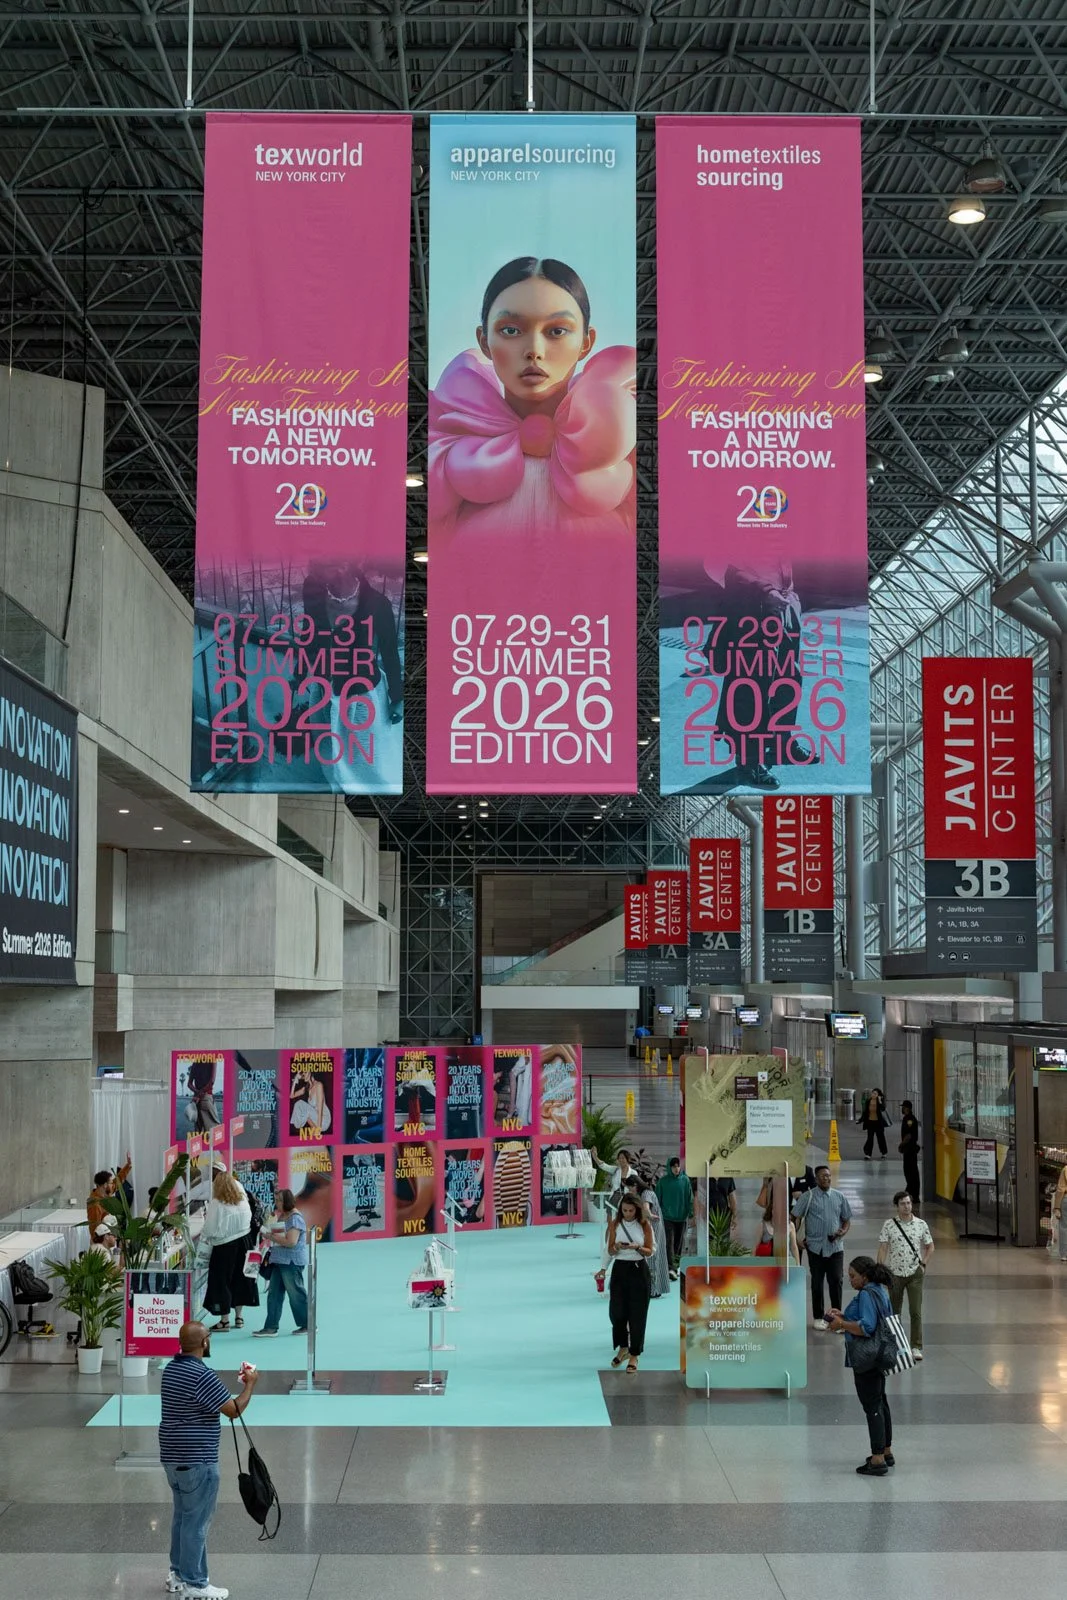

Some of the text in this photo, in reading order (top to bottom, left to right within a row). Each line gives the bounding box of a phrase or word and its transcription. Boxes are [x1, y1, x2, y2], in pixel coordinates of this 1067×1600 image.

[255, 143, 363, 166] texworld
[450, 143, 615, 168] apparelsourcing
[697, 145, 821, 164] hometextiles
[256, 171, 345, 182] NEW YORK CITY
[451, 171, 540, 180] NEW YORK CITY
[697, 168, 783, 190] sourcing
[204, 354, 359, 395] Fashioning
[662, 357, 816, 398] Fashioning
[232, 408, 374, 427] FASHIONING
[691, 411, 832, 429] FASHIONING
[265, 428, 341, 445] A NEW
[724, 431, 800, 448] A NEW
[228, 447, 376, 466] TOMORROW.
[688, 450, 835, 468] TOMORROW.
[275, 483, 320, 519] 20
[737, 486, 781, 522] 20
[214, 613, 373, 646] 07.29-31
[451, 614, 608, 646] 07.29-31
[683, 616, 843, 647] 07.29-31
[214, 646, 375, 675] SUMMER
[452, 647, 611, 675] SUMMER
[684, 649, 844, 677] SUMMER
[212, 676, 376, 731] 2026
[451, 676, 613, 730] 2026
[684, 678, 846, 732] 2026
[211, 731, 374, 765] EDITION
[450, 731, 611, 764] EDITION
[683, 734, 845, 765] EDITION
[944, 684, 976, 831] JAVITS
[991, 684, 1016, 832] CENTER
[0, 768, 69, 842] NOVATION
[776, 798, 797, 891] JAVITS
[806, 798, 822, 892] CENTER
[699, 850, 714, 919] JAVITS
[721, 850, 732, 920] CENTER
[954, 859, 1010, 898] 3B
[655, 880, 666, 934] JAVITS
[672, 880, 680, 935] CENTER
[630, 894, 640, 940] JAVITS
[783, 910, 816, 933] 1B
[2, 927, 72, 958] Summer 2026 Edition
[702, 932, 729, 950] 3A
[658, 944, 678, 958] 1A
[294, 1052, 331, 1062] APPAREL
[405, 1051, 427, 1060] HOME
[494, 1048, 532, 1058] TEXWORLD
[291, 1063, 333, 1072] SOURCING
[347, 1068, 382, 1077] 20 YEARS
[398, 1061, 433, 1070] TEXTILES
[448, 1065, 481, 1075] 20 YEARS
[248, 1070, 276, 1079] YEARS
[351, 1078, 378, 1088] WOVEN
[452, 1075, 478, 1084] WOVEN
[243, 1080, 272, 1090] WOVEN
[348, 1088, 382, 1097] INTO THE
[449, 1085, 480, 1094] INTO THE
[240, 1091, 275, 1100] INTO THE
[346, 1099, 382, 1108] INDUSTRY
[447, 1095, 482, 1104] INDUSTRY
[237, 1101, 276, 1111] INDUSTRY
[300, 1127, 322, 1140] NYC
[403, 1122, 425, 1136] NYC
[502, 1119, 523, 1131] NYC
[404, 1147, 426, 1156] HOME
[347, 1165, 381, 1176] 20 YEARS
[397, 1157, 432, 1168] TEXTILES
[458, 1160, 480, 1169] YEARS
[249, 1171, 275, 1181] YEARS
[395, 1167, 434, 1178] SOURCING
[260, 1193, 274, 1202] THE
[404, 1219, 426, 1233] NYC
[503, 1212, 523, 1225] NYC
[709, 1294, 757, 1305] texworld
[138, 1307, 179, 1315] Suitcases
[147, 1326, 170, 1334] Point
[709, 1318, 784, 1330] apparelsourcing
[710, 1343, 761, 1351] hometextiles
[710, 1352, 745, 1362] sourcing
